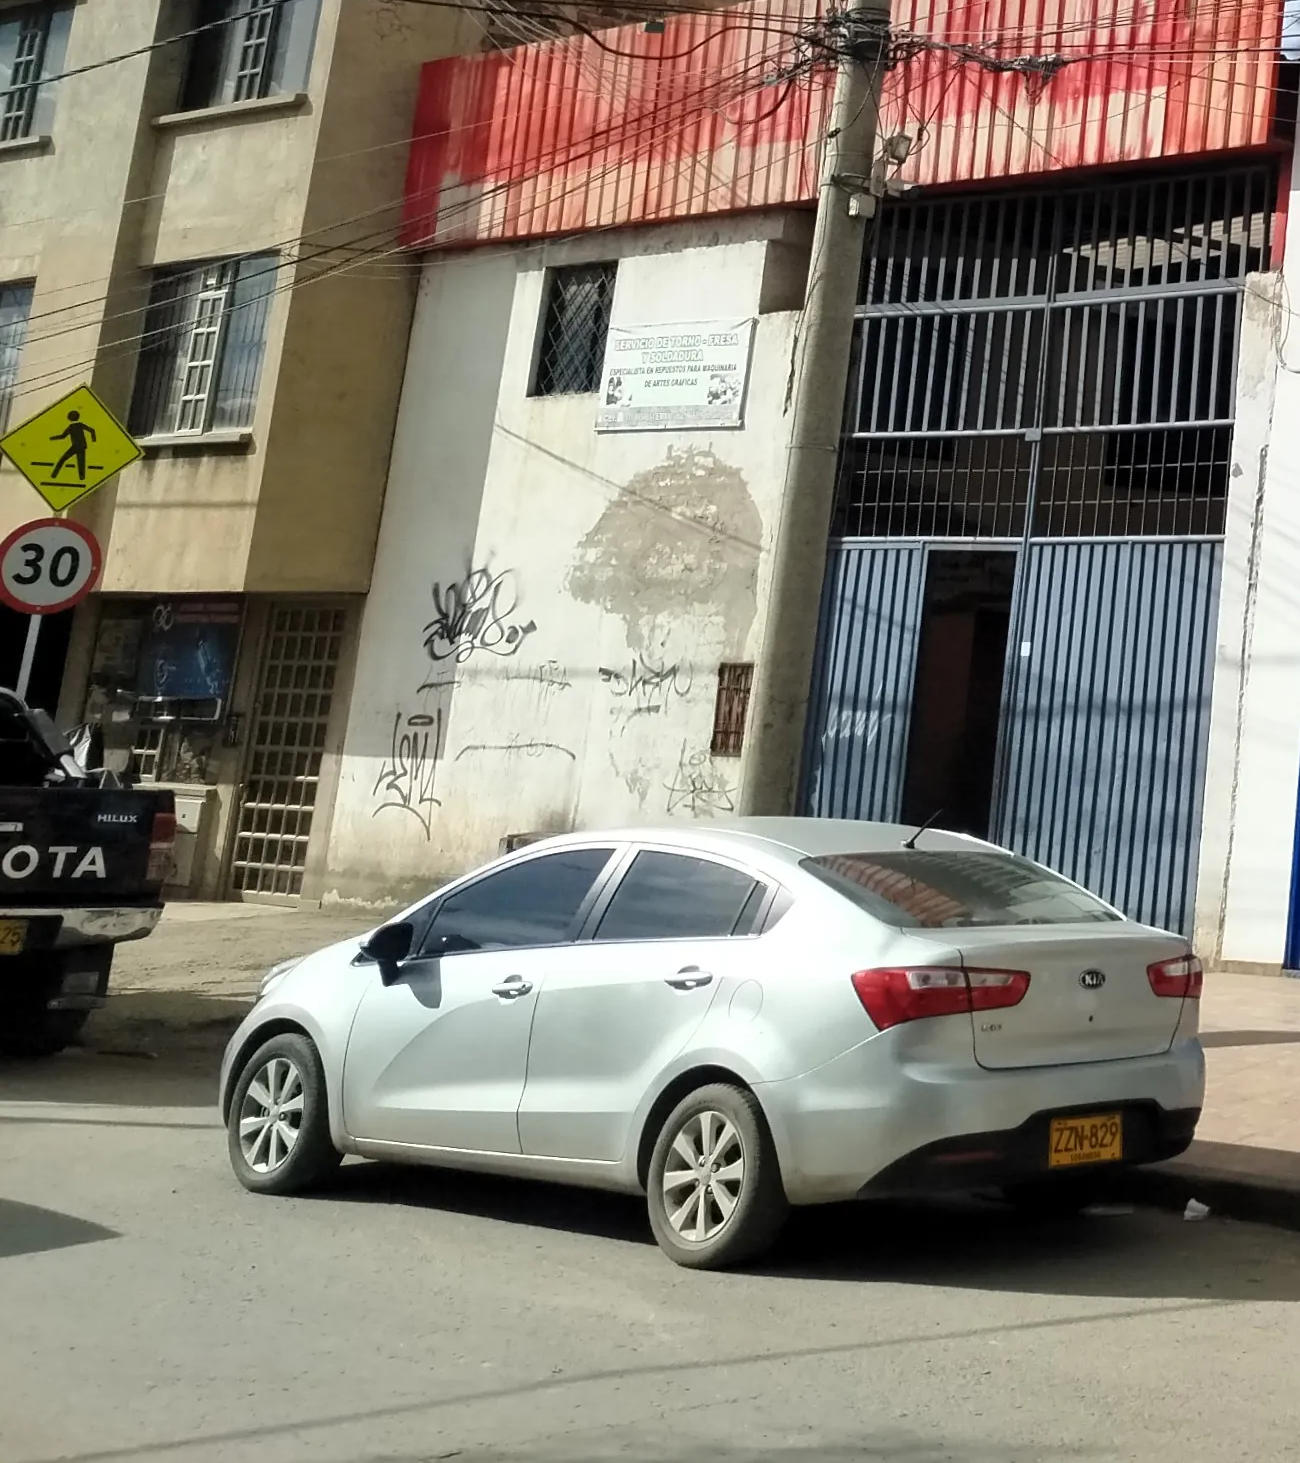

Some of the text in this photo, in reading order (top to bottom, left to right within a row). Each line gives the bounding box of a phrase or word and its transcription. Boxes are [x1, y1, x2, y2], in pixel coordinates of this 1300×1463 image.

[614, 337, 654, 351] SERVICIO
[655, 336, 669, 349] DE
[670, 335, 701, 348] TORNO
[707, 333, 739, 347] FRESA
[641, 349, 704, 364] Y SOLDADURA
[646, 366, 654, 374] EN
[11, 541, 80, 589] 30
[97, 814, 138, 823] HILUX
[1053, 1121, 1119, 1154] ZZN-829
